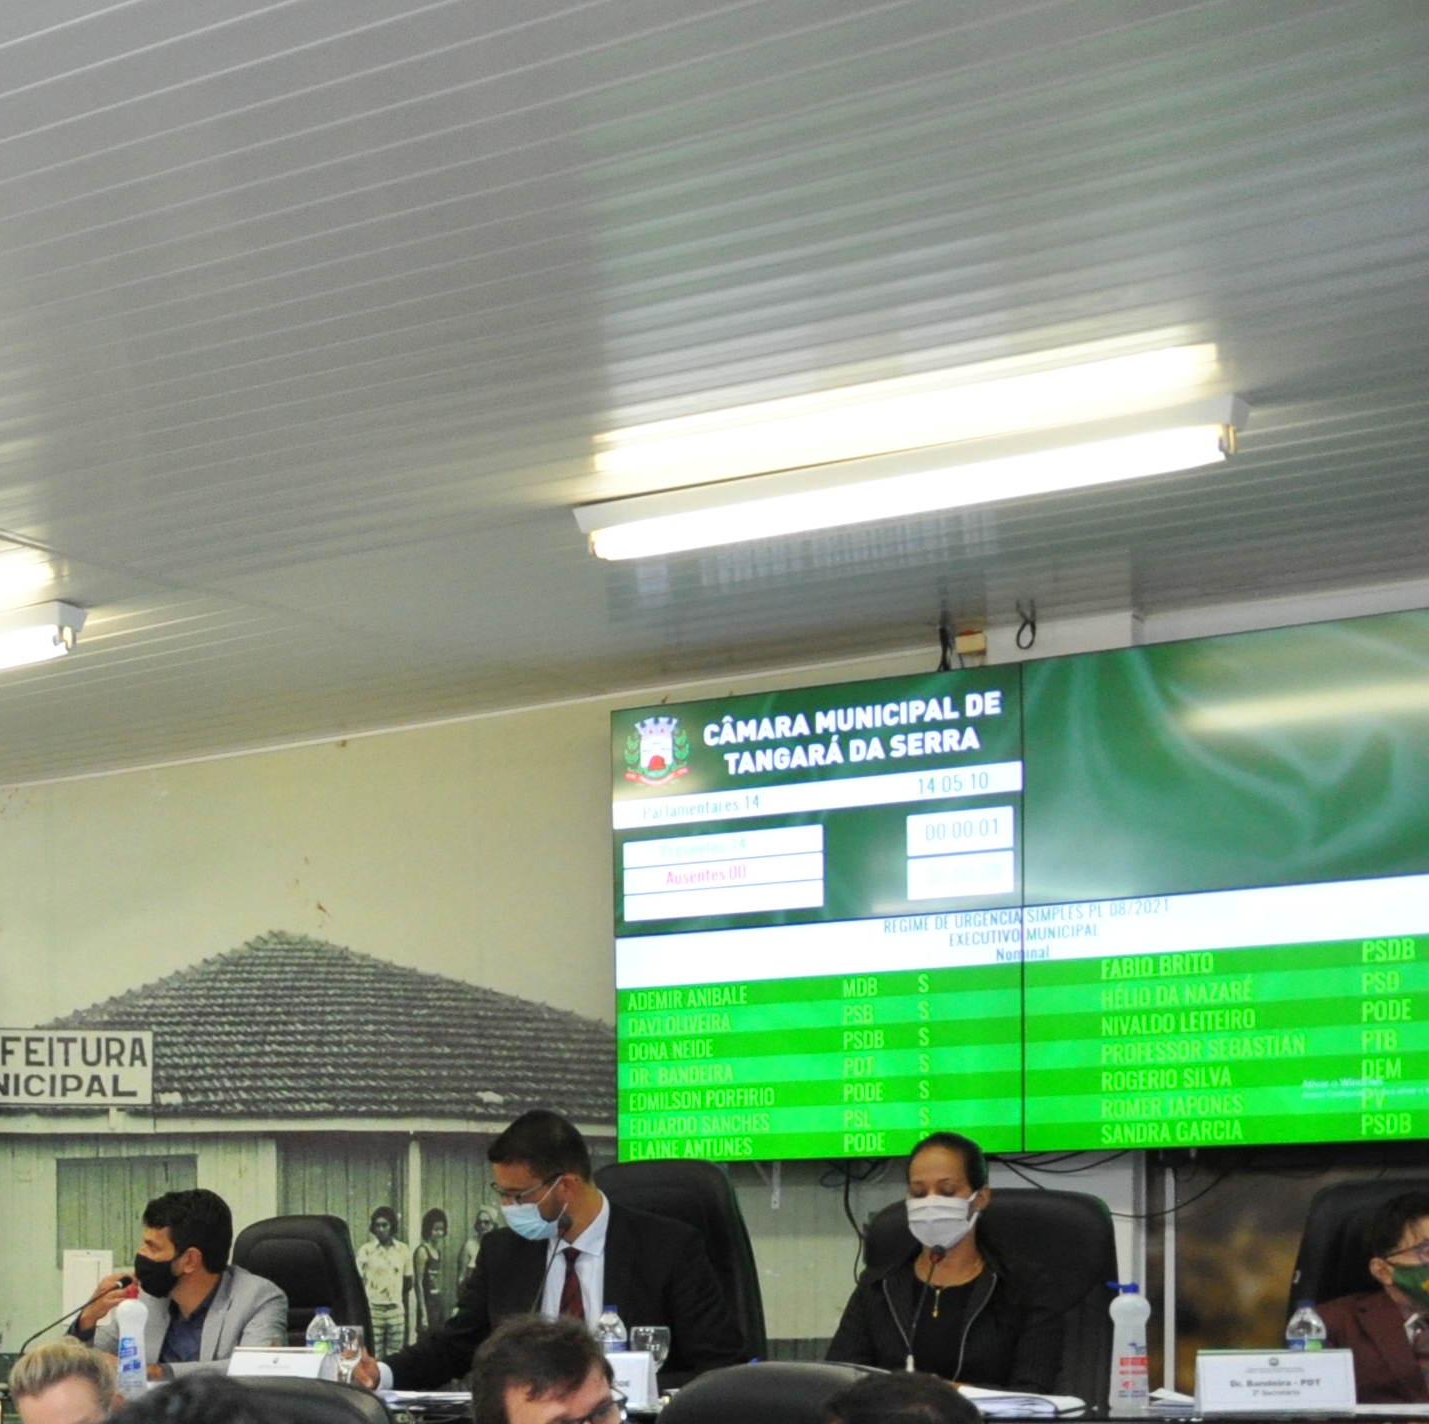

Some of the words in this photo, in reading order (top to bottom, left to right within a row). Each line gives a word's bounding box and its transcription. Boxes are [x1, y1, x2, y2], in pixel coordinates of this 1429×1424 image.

[703, 713, 804, 746] CÂMARA
[815, 697, 960, 732] MUNICIPAL
[965, 691, 1002, 718] DE
[724, 737, 843, 775] TANGARÁ
[849, 735, 885, 762] DA
[890, 726, 981, 758] SERRA
[918, 771, 990, 796] 14:05:10
[643, 799, 739, 820] Parlamentares
[744, 794, 760, 810] 14
[666, 868, 725, 886] Ausentes
[883, 914, 930, 934] REGIME
[934, 914, 950, 930] DE
[1026, 902, 1083, 924] SIMPLES
[1088, 902, 1102, 918] PL
[1109, 896, 1169, 917] 08/2021
[949, 929, 1021, 948] EXECUTIVO
[1026, 923, 1099, 942] MUNICIPAL
[995, 945, 1050, 963] Nominal
[1159, 952, 1214, 976] BRITO
[1362, 937, 1416, 964] PSDB
[628, 989, 683, 1011] ADEMIR
[686, 985, 748, 1007] ANIBALE
[843, 976, 878, 998] MDB
[918, 974, 930, 994] S
[1101, 981, 1151, 1010] HÉLIO
[1158, 984, 1180, 1006] DA
[1185, 974, 1253, 1003] NAZARÉ
[1362, 970, 1401, 994] PSD
[628, 1015, 663, 1036] DAVI
[665, 1012, 731, 1034] OLIVEIRA
[843, 1003, 874, 1025] PSB
[919, 1001, 930, 1020] S
[1101, 1013, 1176, 1037] NIVALDO
[1180, 1008, 1256, 1032] LEITEIRO
[1362, 998, 1412, 1023] PODE
[628, 1041, 668, 1062] DONA
[672, 1038, 714, 1058] NEIDE
[843, 1029, 885, 1051] PSDB
[919, 1027, 930, 1047] S
[1101, 1039, 1202, 1064] PROFESSOR
[1208, 1034, 1306, 1059] SEBASTIAN
[1362, 1028, 1398, 1051] PTB
[628, 1067, 654, 1087] DR.
[657, 1063, 734, 1084] BANDEIRA
[844, 1056, 875, 1077] PDT
[919, 1054, 931, 1073] S
[1183, 1066, 1232, 1088] SILVA
[1362, 1058, 1402, 1080] DEM
[628, 1090, 702, 1112] EDMILSON
[843, 1082, 884, 1103] PODE
[919, 1080, 931, 1100] S
[1101, 1096, 1162, 1119] ROMER
[1362, 1087, 1387, 1109] PV
[629, 1114, 698, 1136] EDUARDO
[701, 1112, 771, 1132] SANCHES
[844, 1109, 871, 1129] PSL
[919, 1106, 931, 1126] S
[1101, 1121, 1171, 1144] SANDRA
[1361, 1113, 1412, 1135] PSDB
[629, 1138, 682, 1159] ELAINE
[685, 1136, 753, 1157] ANTUNES
[843, 1133, 886, 1153] PODE
